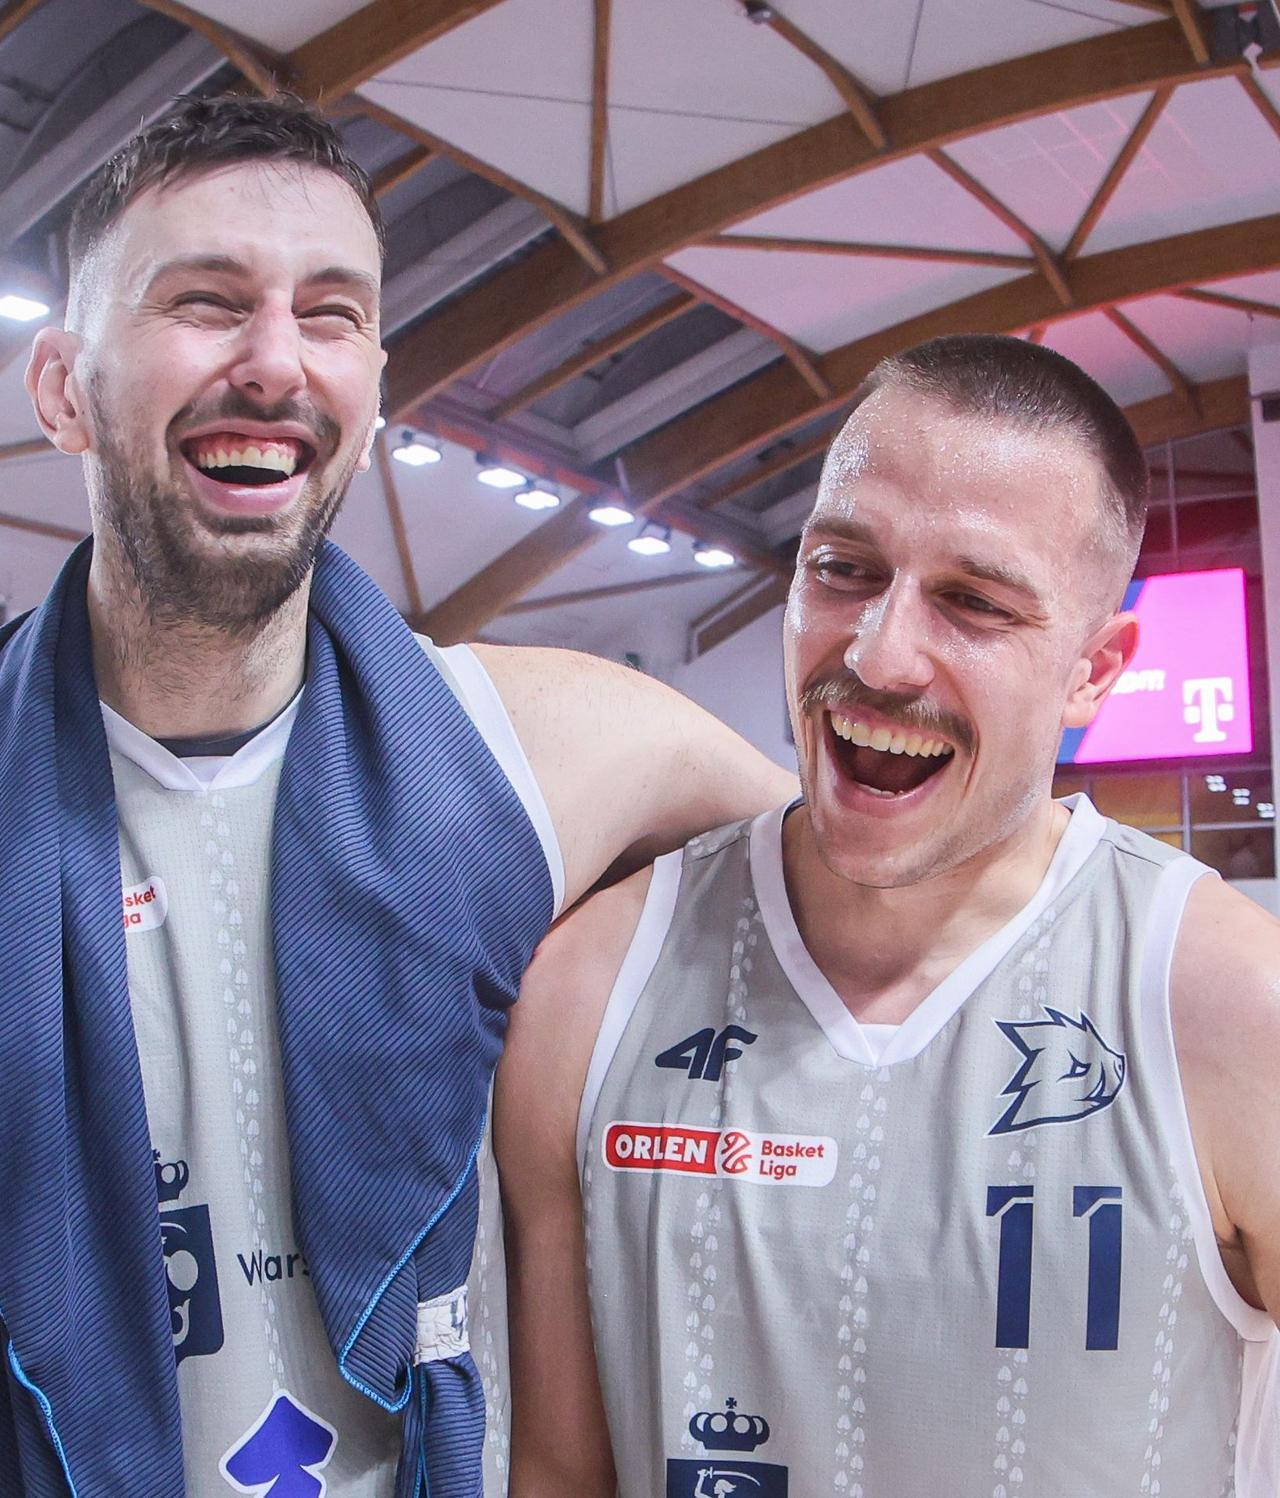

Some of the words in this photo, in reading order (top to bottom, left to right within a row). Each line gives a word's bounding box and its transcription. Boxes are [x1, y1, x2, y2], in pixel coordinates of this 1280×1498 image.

[124, 885, 156, 907] sket
[655, 1024, 758, 1082] 4F
[615, 1134, 708, 1164] ORLEN
[760, 1140, 824, 1159] Basket
[759, 1160, 797, 1180] Liga
[986, 1185, 1123, 1351] 11
